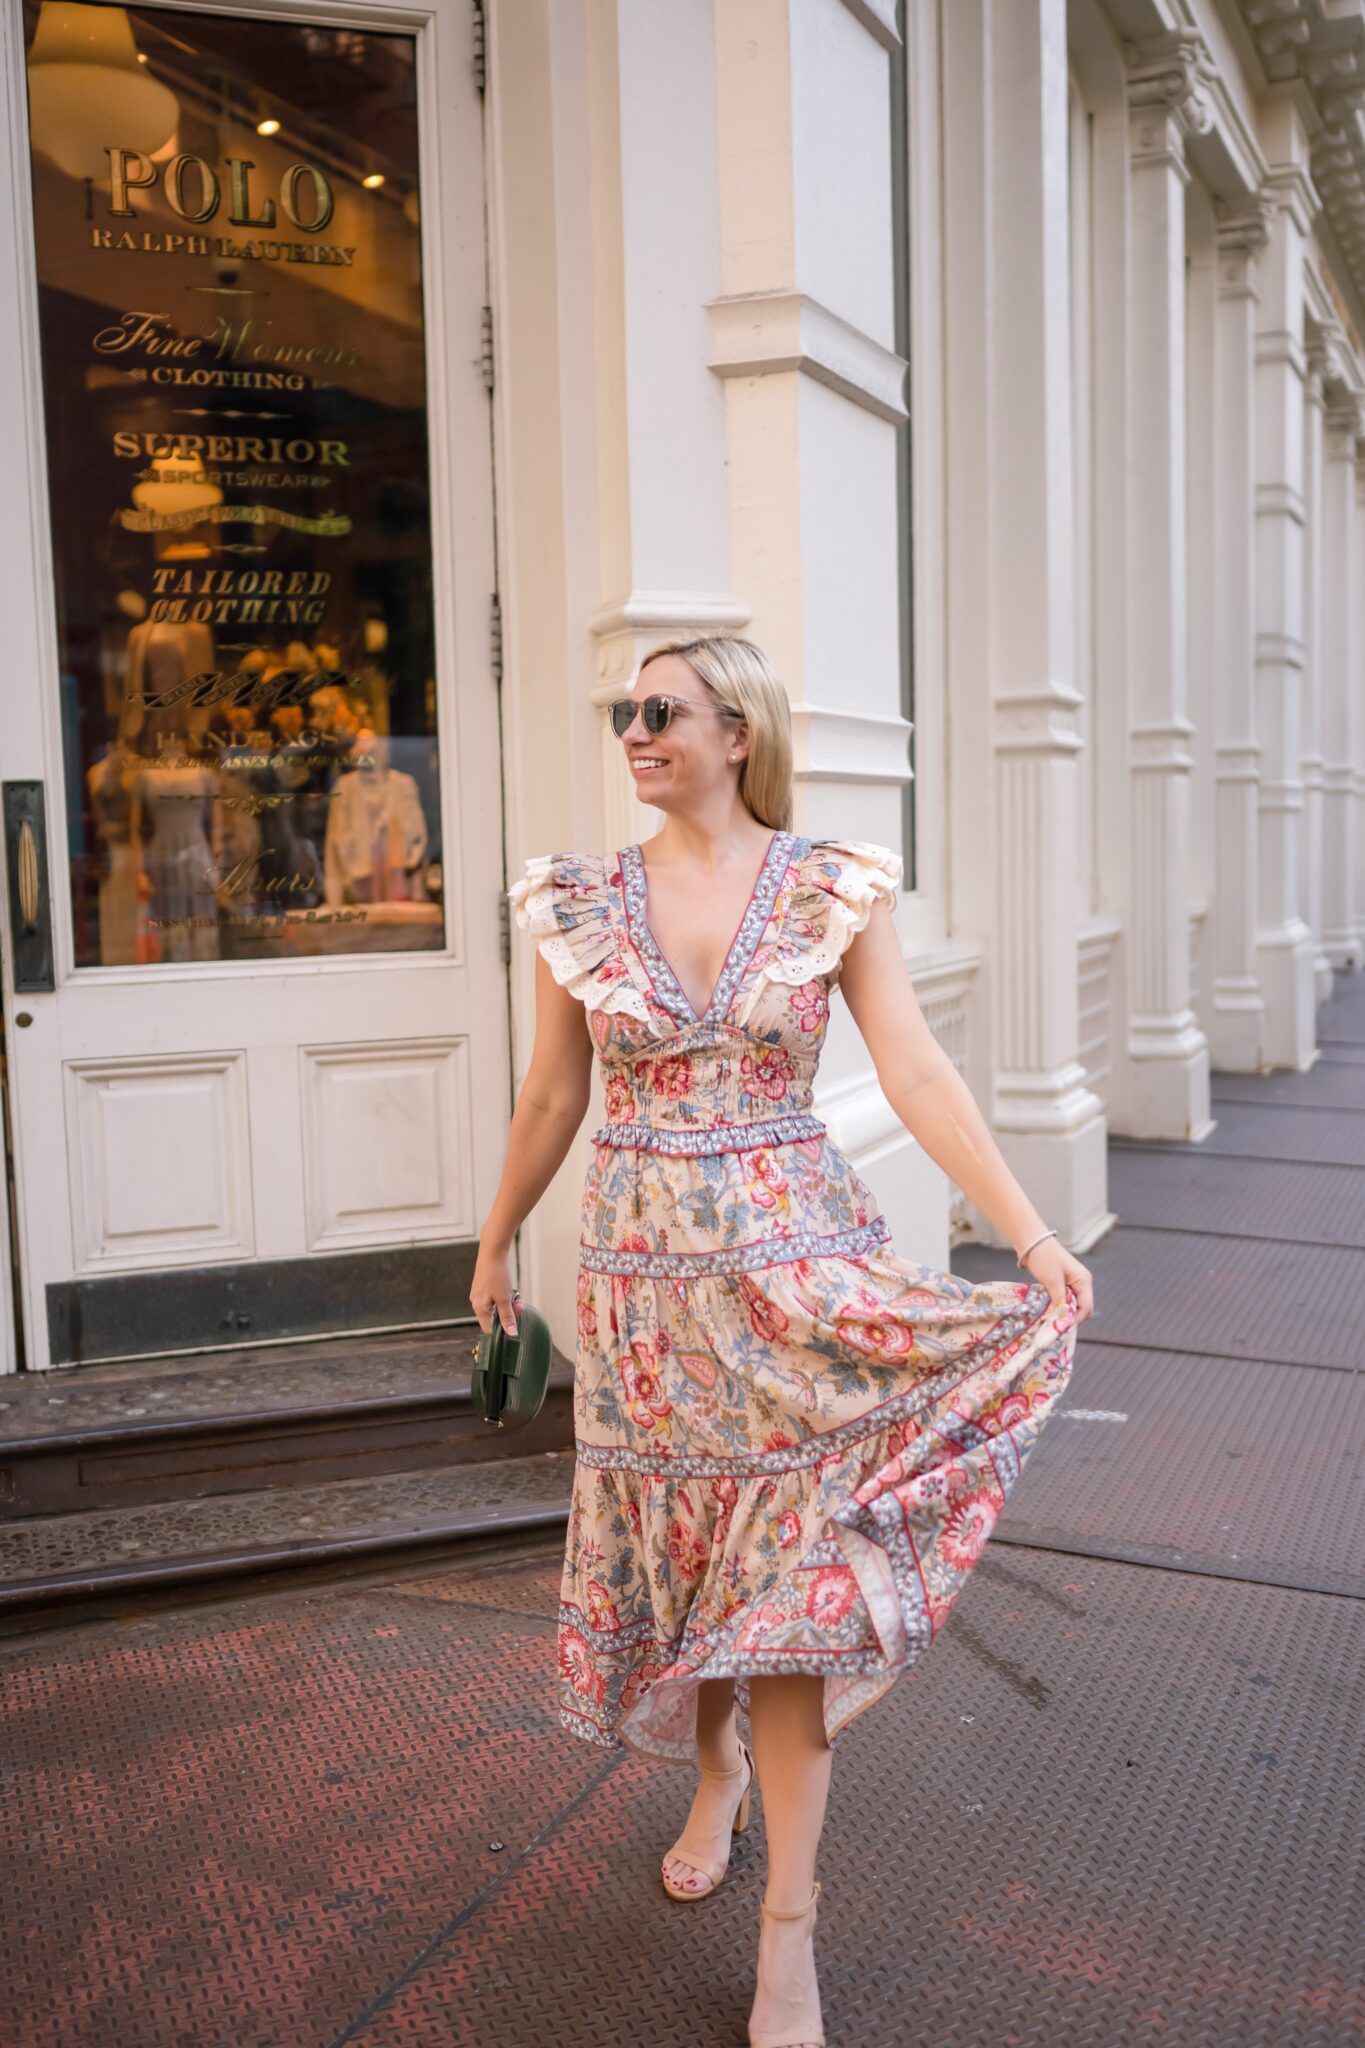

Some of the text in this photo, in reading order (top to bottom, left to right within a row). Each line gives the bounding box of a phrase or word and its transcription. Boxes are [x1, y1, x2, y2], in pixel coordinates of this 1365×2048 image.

[104, 146, 334, 232] POLO
[91, 228, 356, 266] RALPH LAUREN
[92, 311, 201, 358] Fine
[152, 366, 304, 390] CLOTHING
[113, 431, 350, 466] SUPERIOR
[161, 469, 311, 488] SPORTSWEAR
[152, 568, 331, 595] TAILORED
[150, 600, 325, 624] CLOTHING
